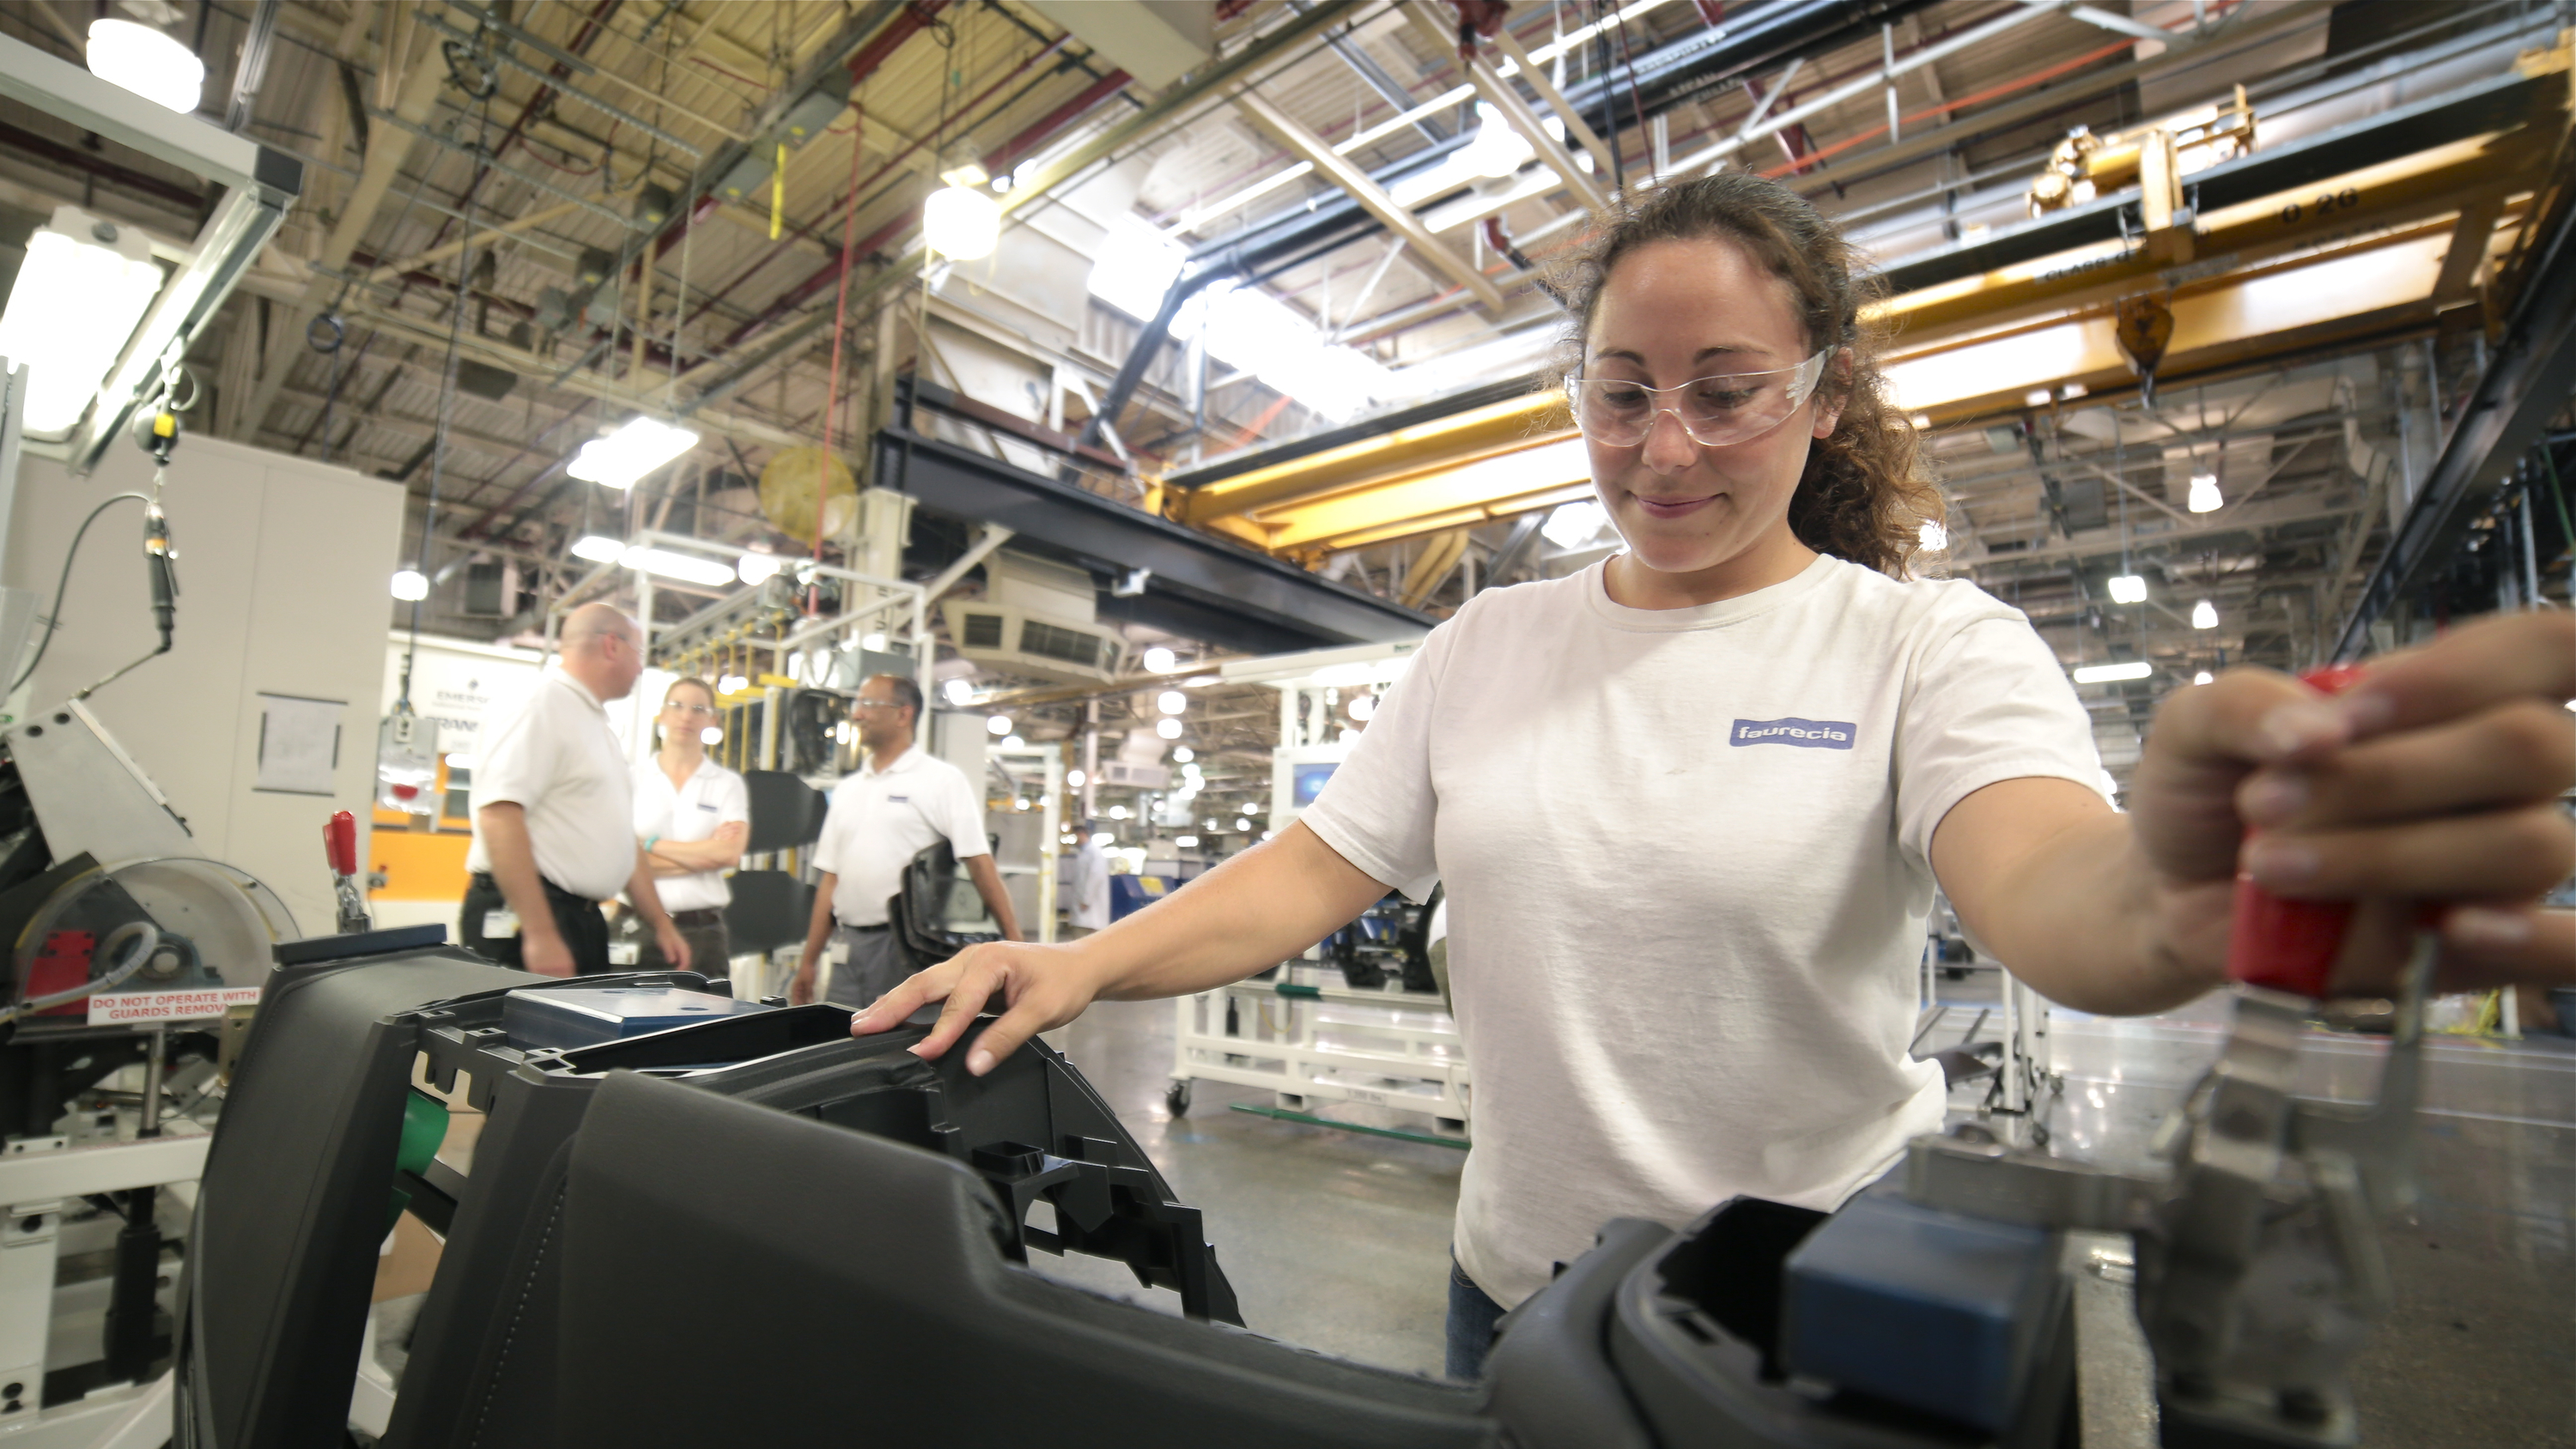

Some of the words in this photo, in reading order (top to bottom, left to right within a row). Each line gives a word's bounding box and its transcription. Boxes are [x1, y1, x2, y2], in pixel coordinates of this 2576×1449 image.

[436, 690, 490, 704] EMERS
[1739, 726, 1847, 743] faurecia
[93, 998, 115, 1009] DO
[120, 997, 152, 1007] NOT
[155, 993, 218, 1005] OPERATE
[222, 991, 257, 1002] WITH
[109, 1006, 170, 1020] GUARDS
[174, 1003, 225, 1015] REMOV
